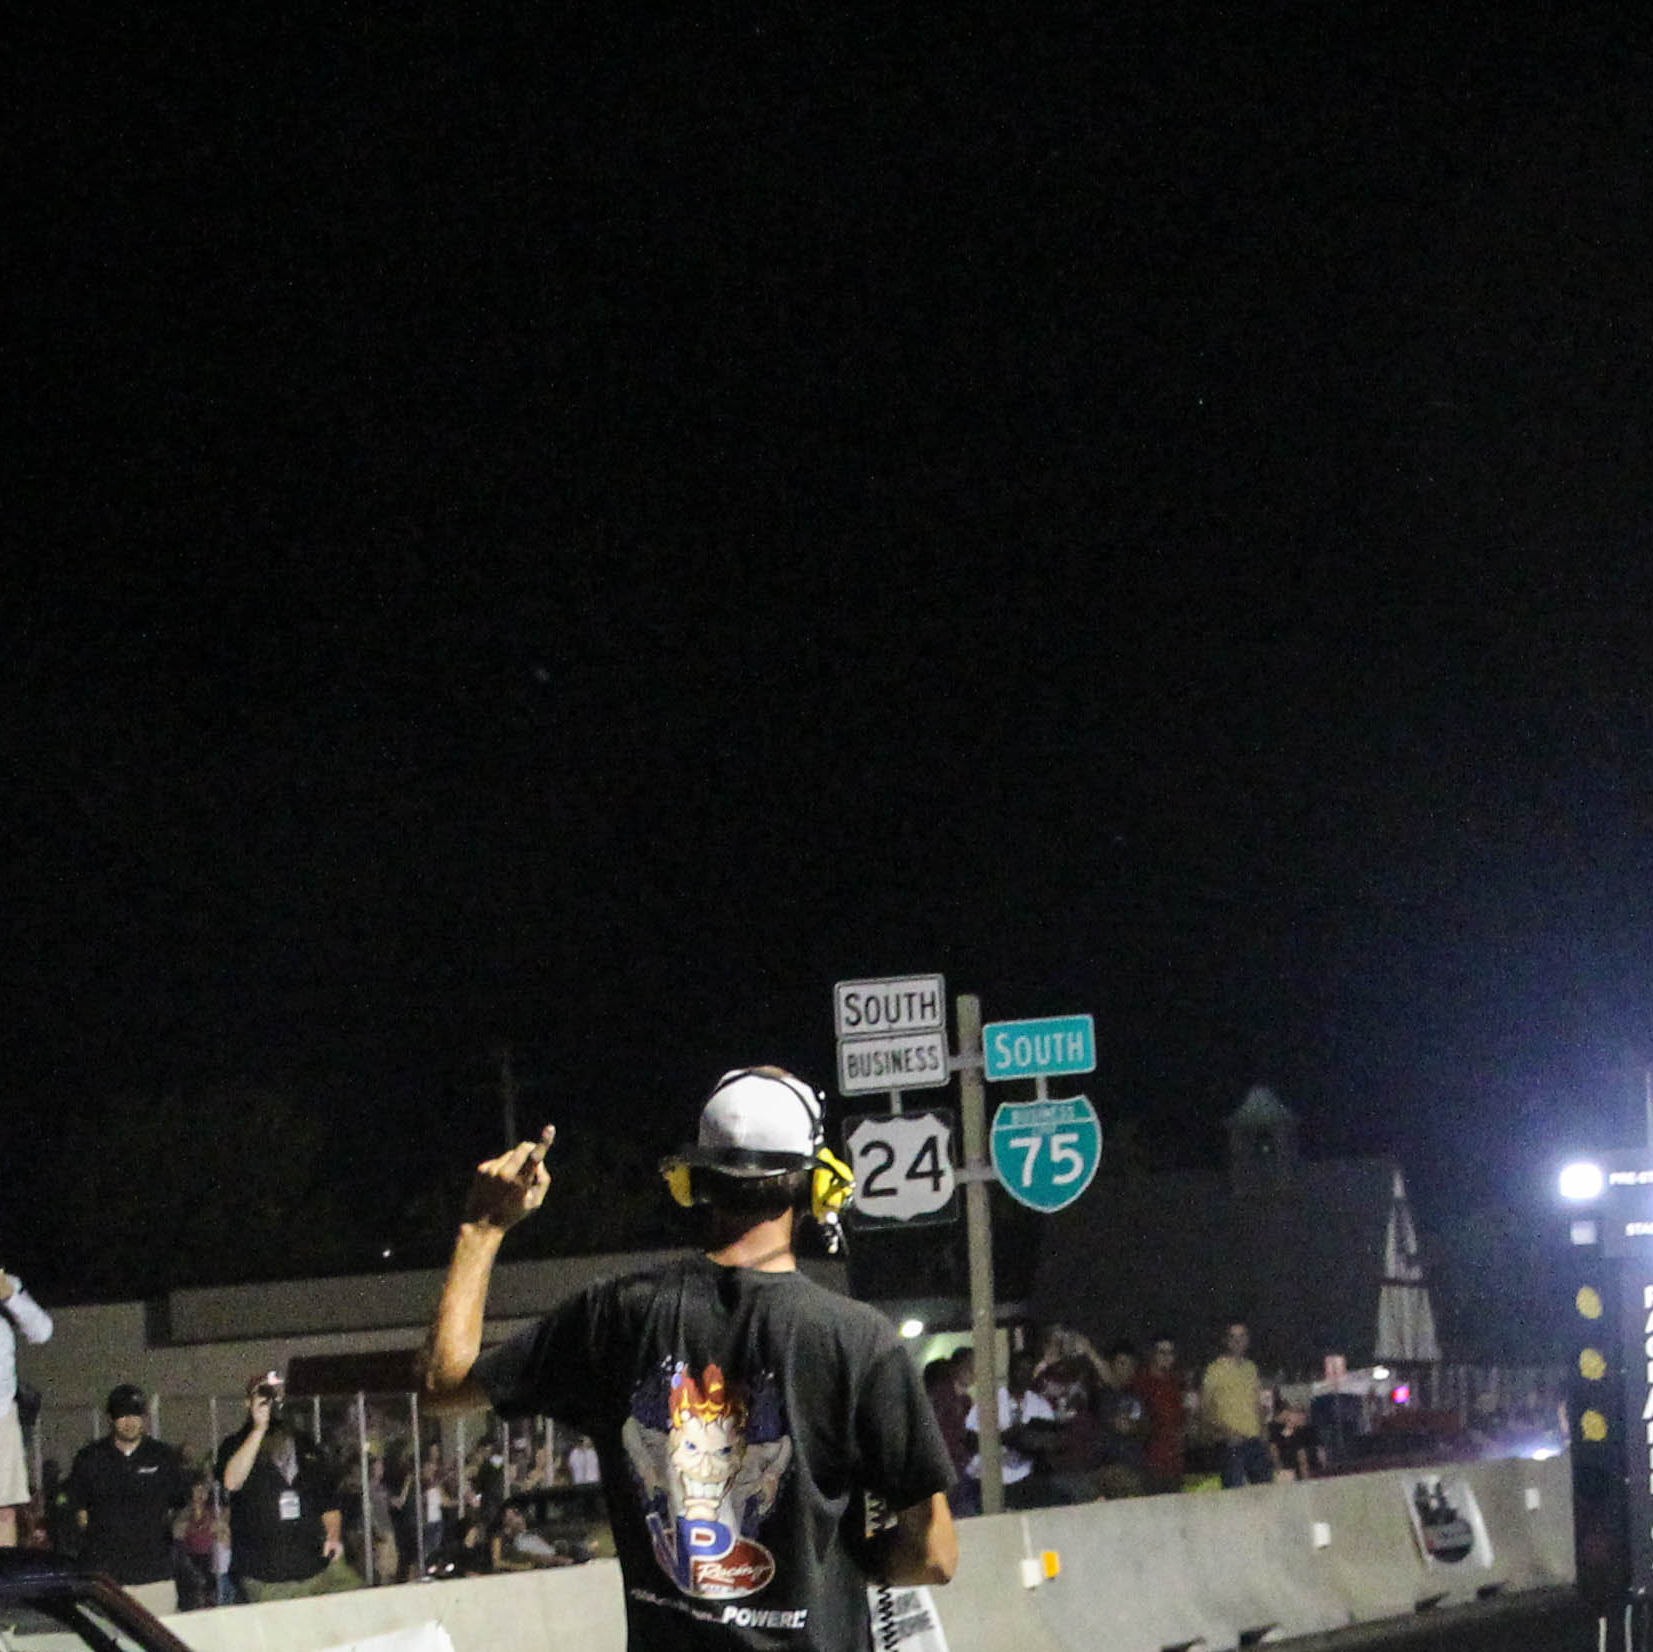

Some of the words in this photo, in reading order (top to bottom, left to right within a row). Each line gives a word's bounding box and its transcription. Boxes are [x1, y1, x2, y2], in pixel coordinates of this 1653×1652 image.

[844, 991, 937, 1026] SOUTH
[847, 1045, 940, 1079] BUSINESS
[995, 1032, 1085, 1068] SOUTH
[858, 1135, 945, 1199] 24
[1008, 1133, 1086, 1188] 75
